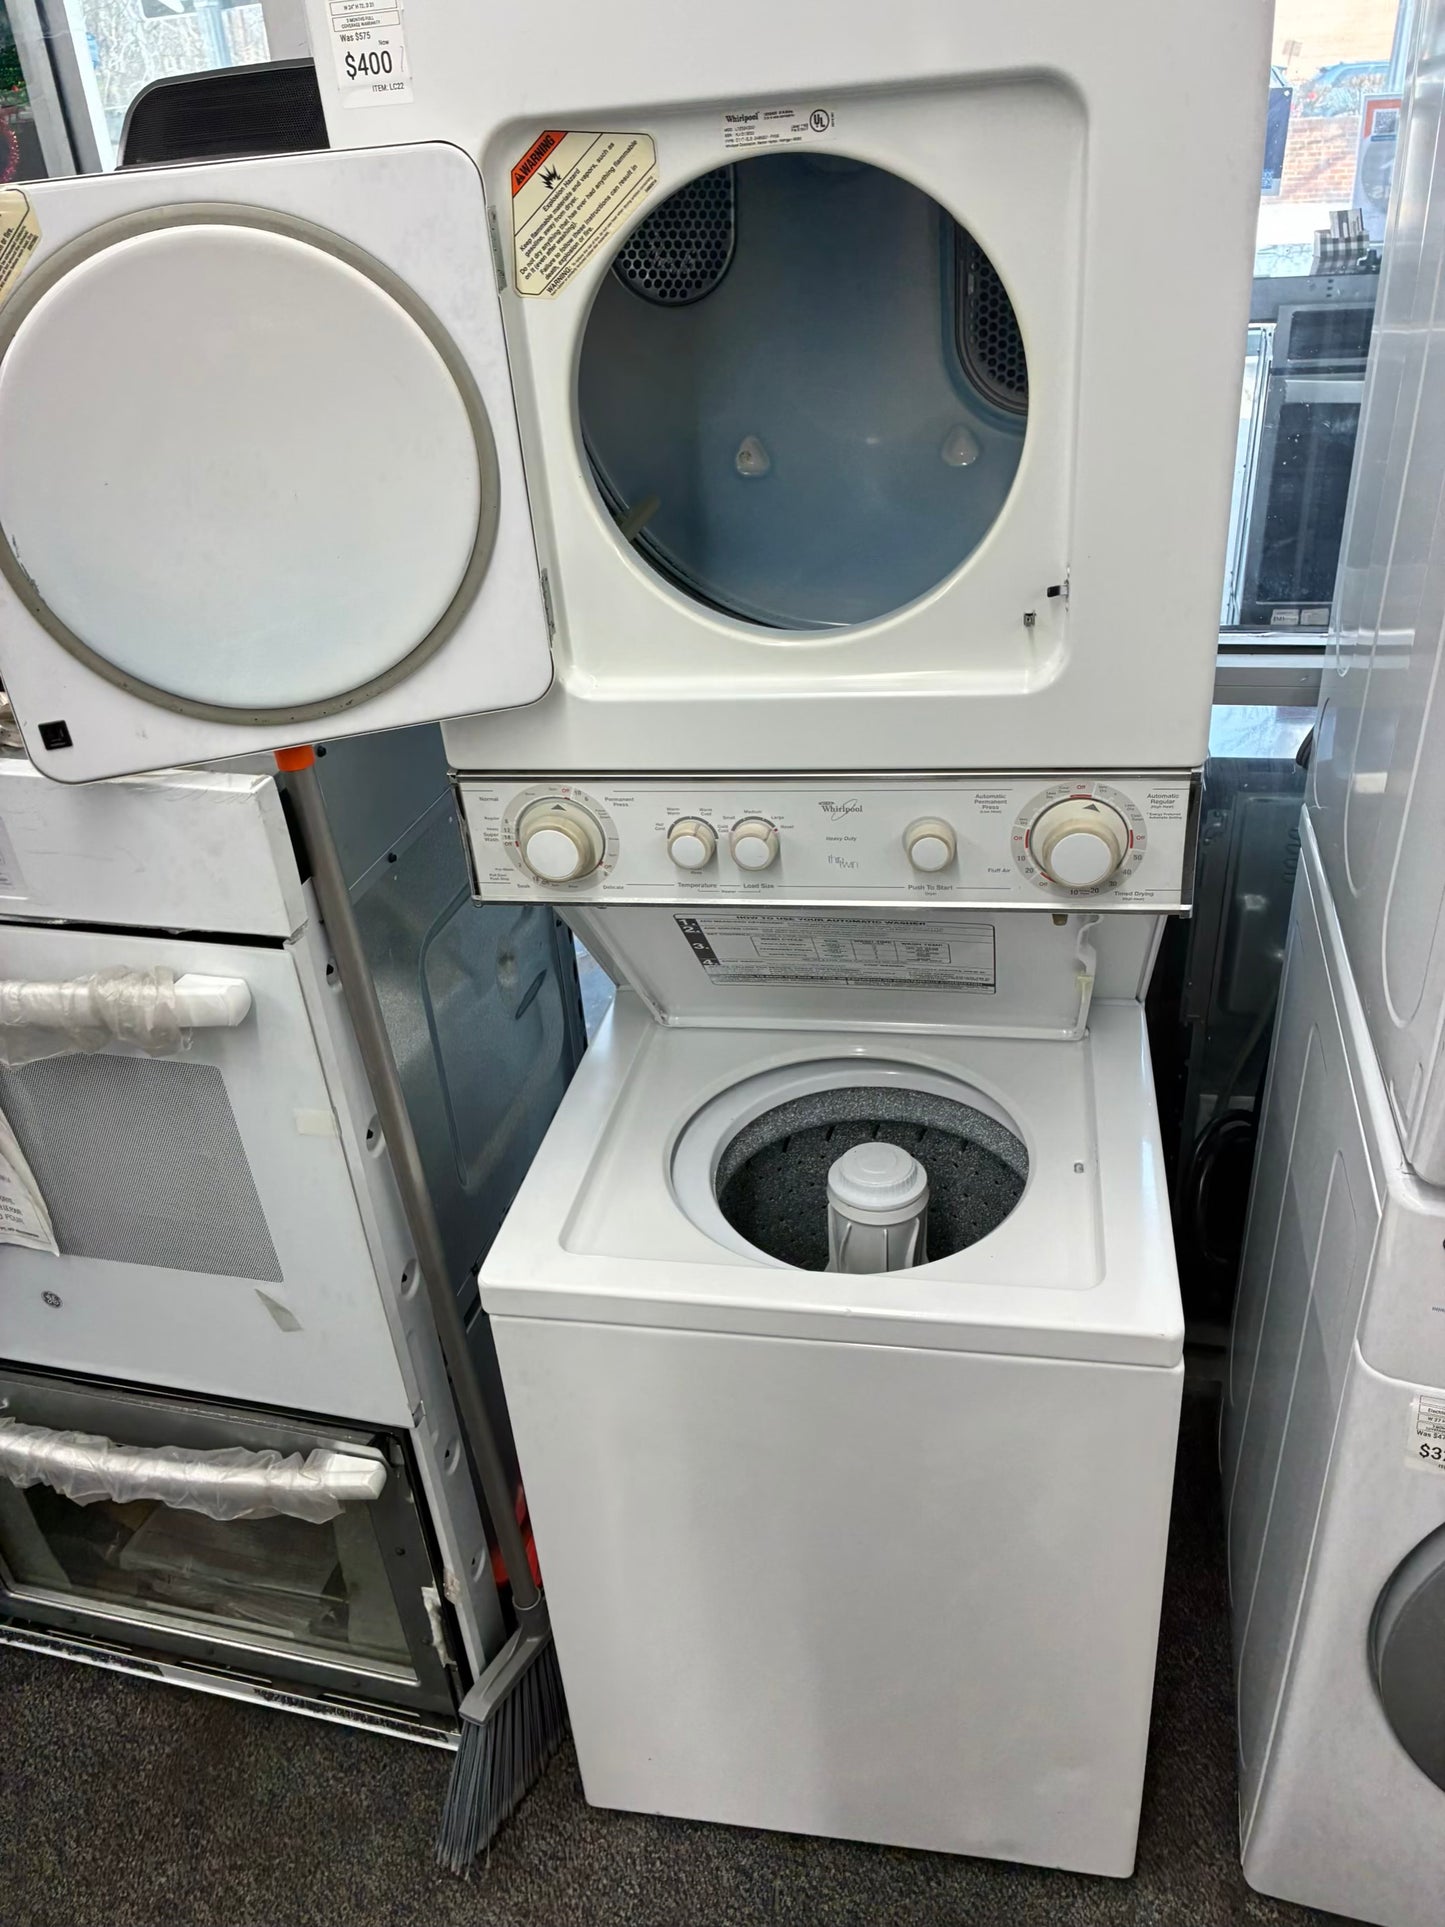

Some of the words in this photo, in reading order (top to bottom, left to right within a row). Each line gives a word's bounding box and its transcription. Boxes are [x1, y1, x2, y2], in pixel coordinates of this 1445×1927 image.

[340, 33, 354, 42] Was
[355, 31, 371, 41] $575
[345, 50, 393, 80] $400
[372, 84, 389, 92] ITEM:
[389, 82, 404, 91] LC22
[519, 134, 555, 175] WARNING
[542, 186, 565, 211] Explosion
[563, 168, 580, 187] Hazard
[609, 184, 619, 195] can
[519, 237, 533, 251] Keep
[570, 181, 581, 191] and
[595, 149, 608, 162] such
[519, 265, 527, 274] Do
[526, 257, 535, 267] not
[540, 228, 561, 251] anything
[593, 165, 616, 190] anything
[553, 209, 566, 222] from
[546, 265, 572, 293] WARNING:
[821, 805, 863, 814] Whirlpool
[692, 942, 710, 950] 3.
[1419, 1443, 1445, 1462] $3
